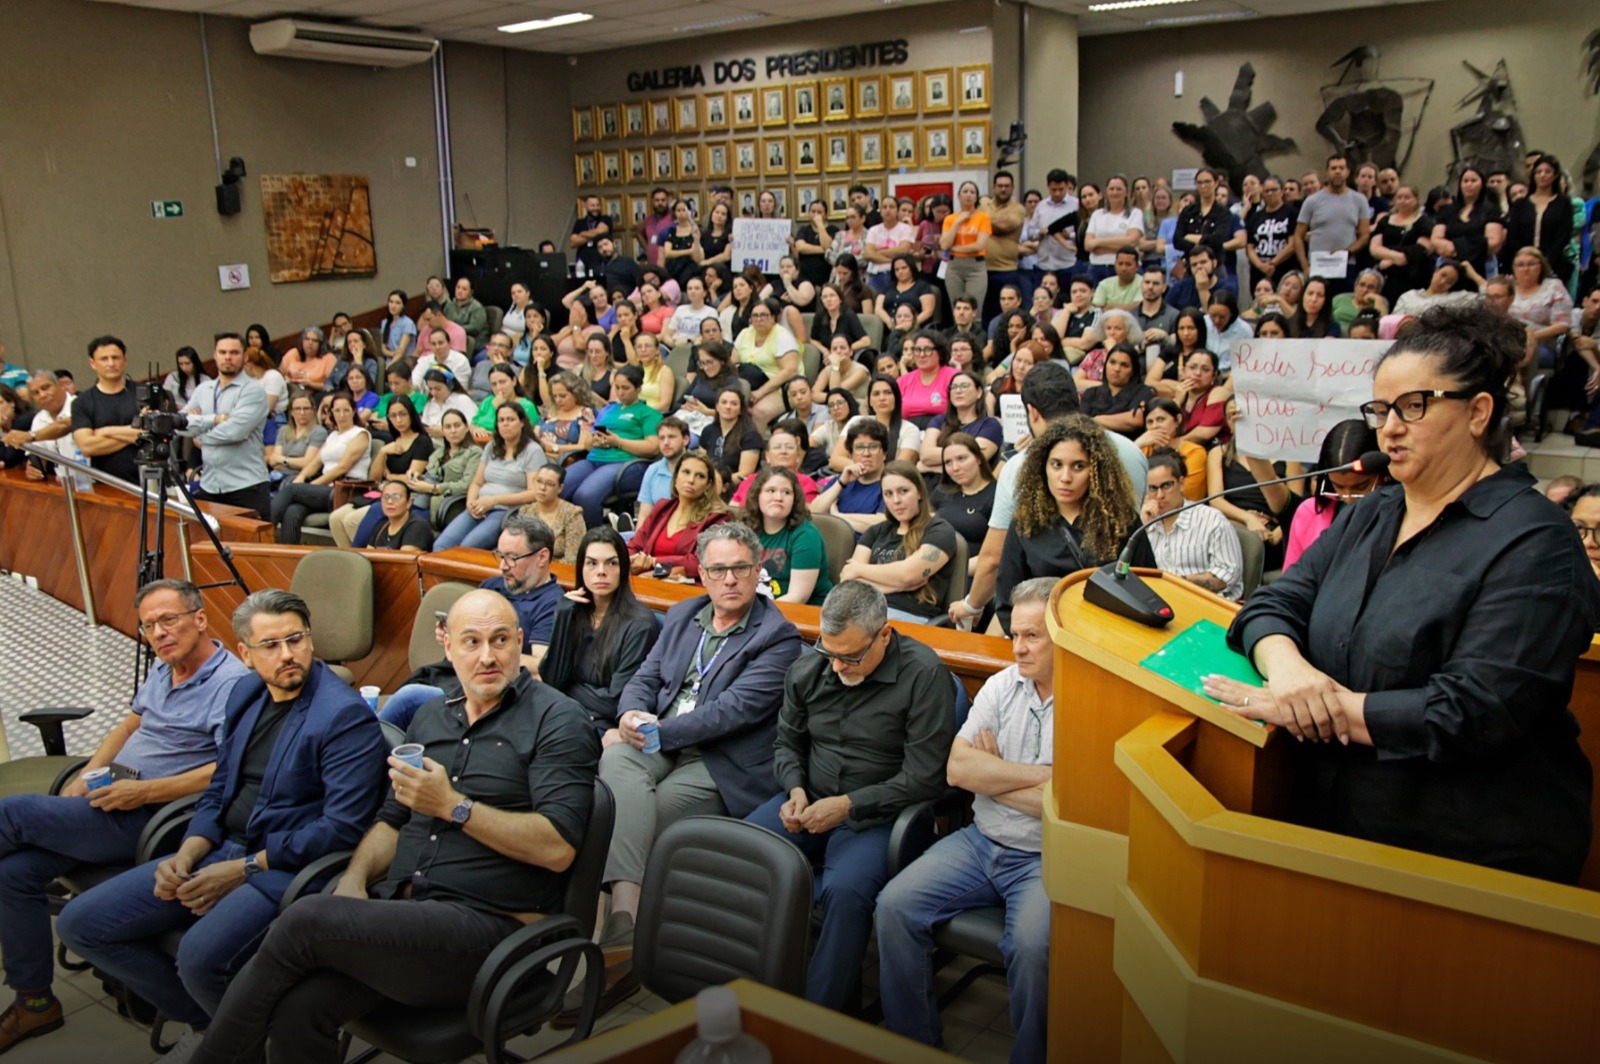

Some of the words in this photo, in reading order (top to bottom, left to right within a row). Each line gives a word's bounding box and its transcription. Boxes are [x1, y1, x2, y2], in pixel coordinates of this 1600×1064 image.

[627, 64, 706, 92] GALERIA
[714, 58, 756, 84] DOS
[765, 38, 909, 80] PRESIDENTES
[1238, 390, 1297, 418] Não
